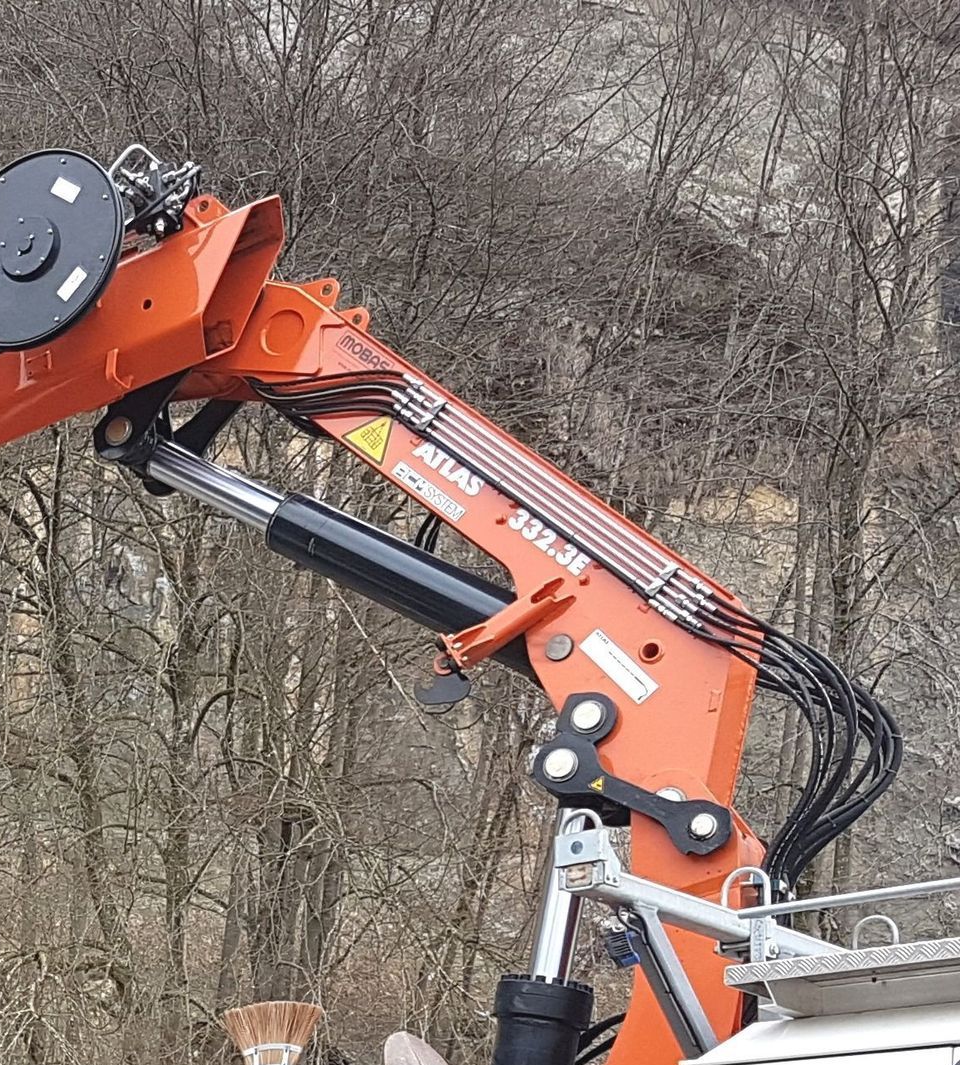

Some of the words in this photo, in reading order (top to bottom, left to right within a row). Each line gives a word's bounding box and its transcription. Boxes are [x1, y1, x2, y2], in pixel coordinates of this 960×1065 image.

[340, 334, 391, 371] MOBAS
[412, 441, 485, 497] ATLAS
[422, 485, 463, 520] SYSTEM
[506, 509, 591, 576] 332.3E
